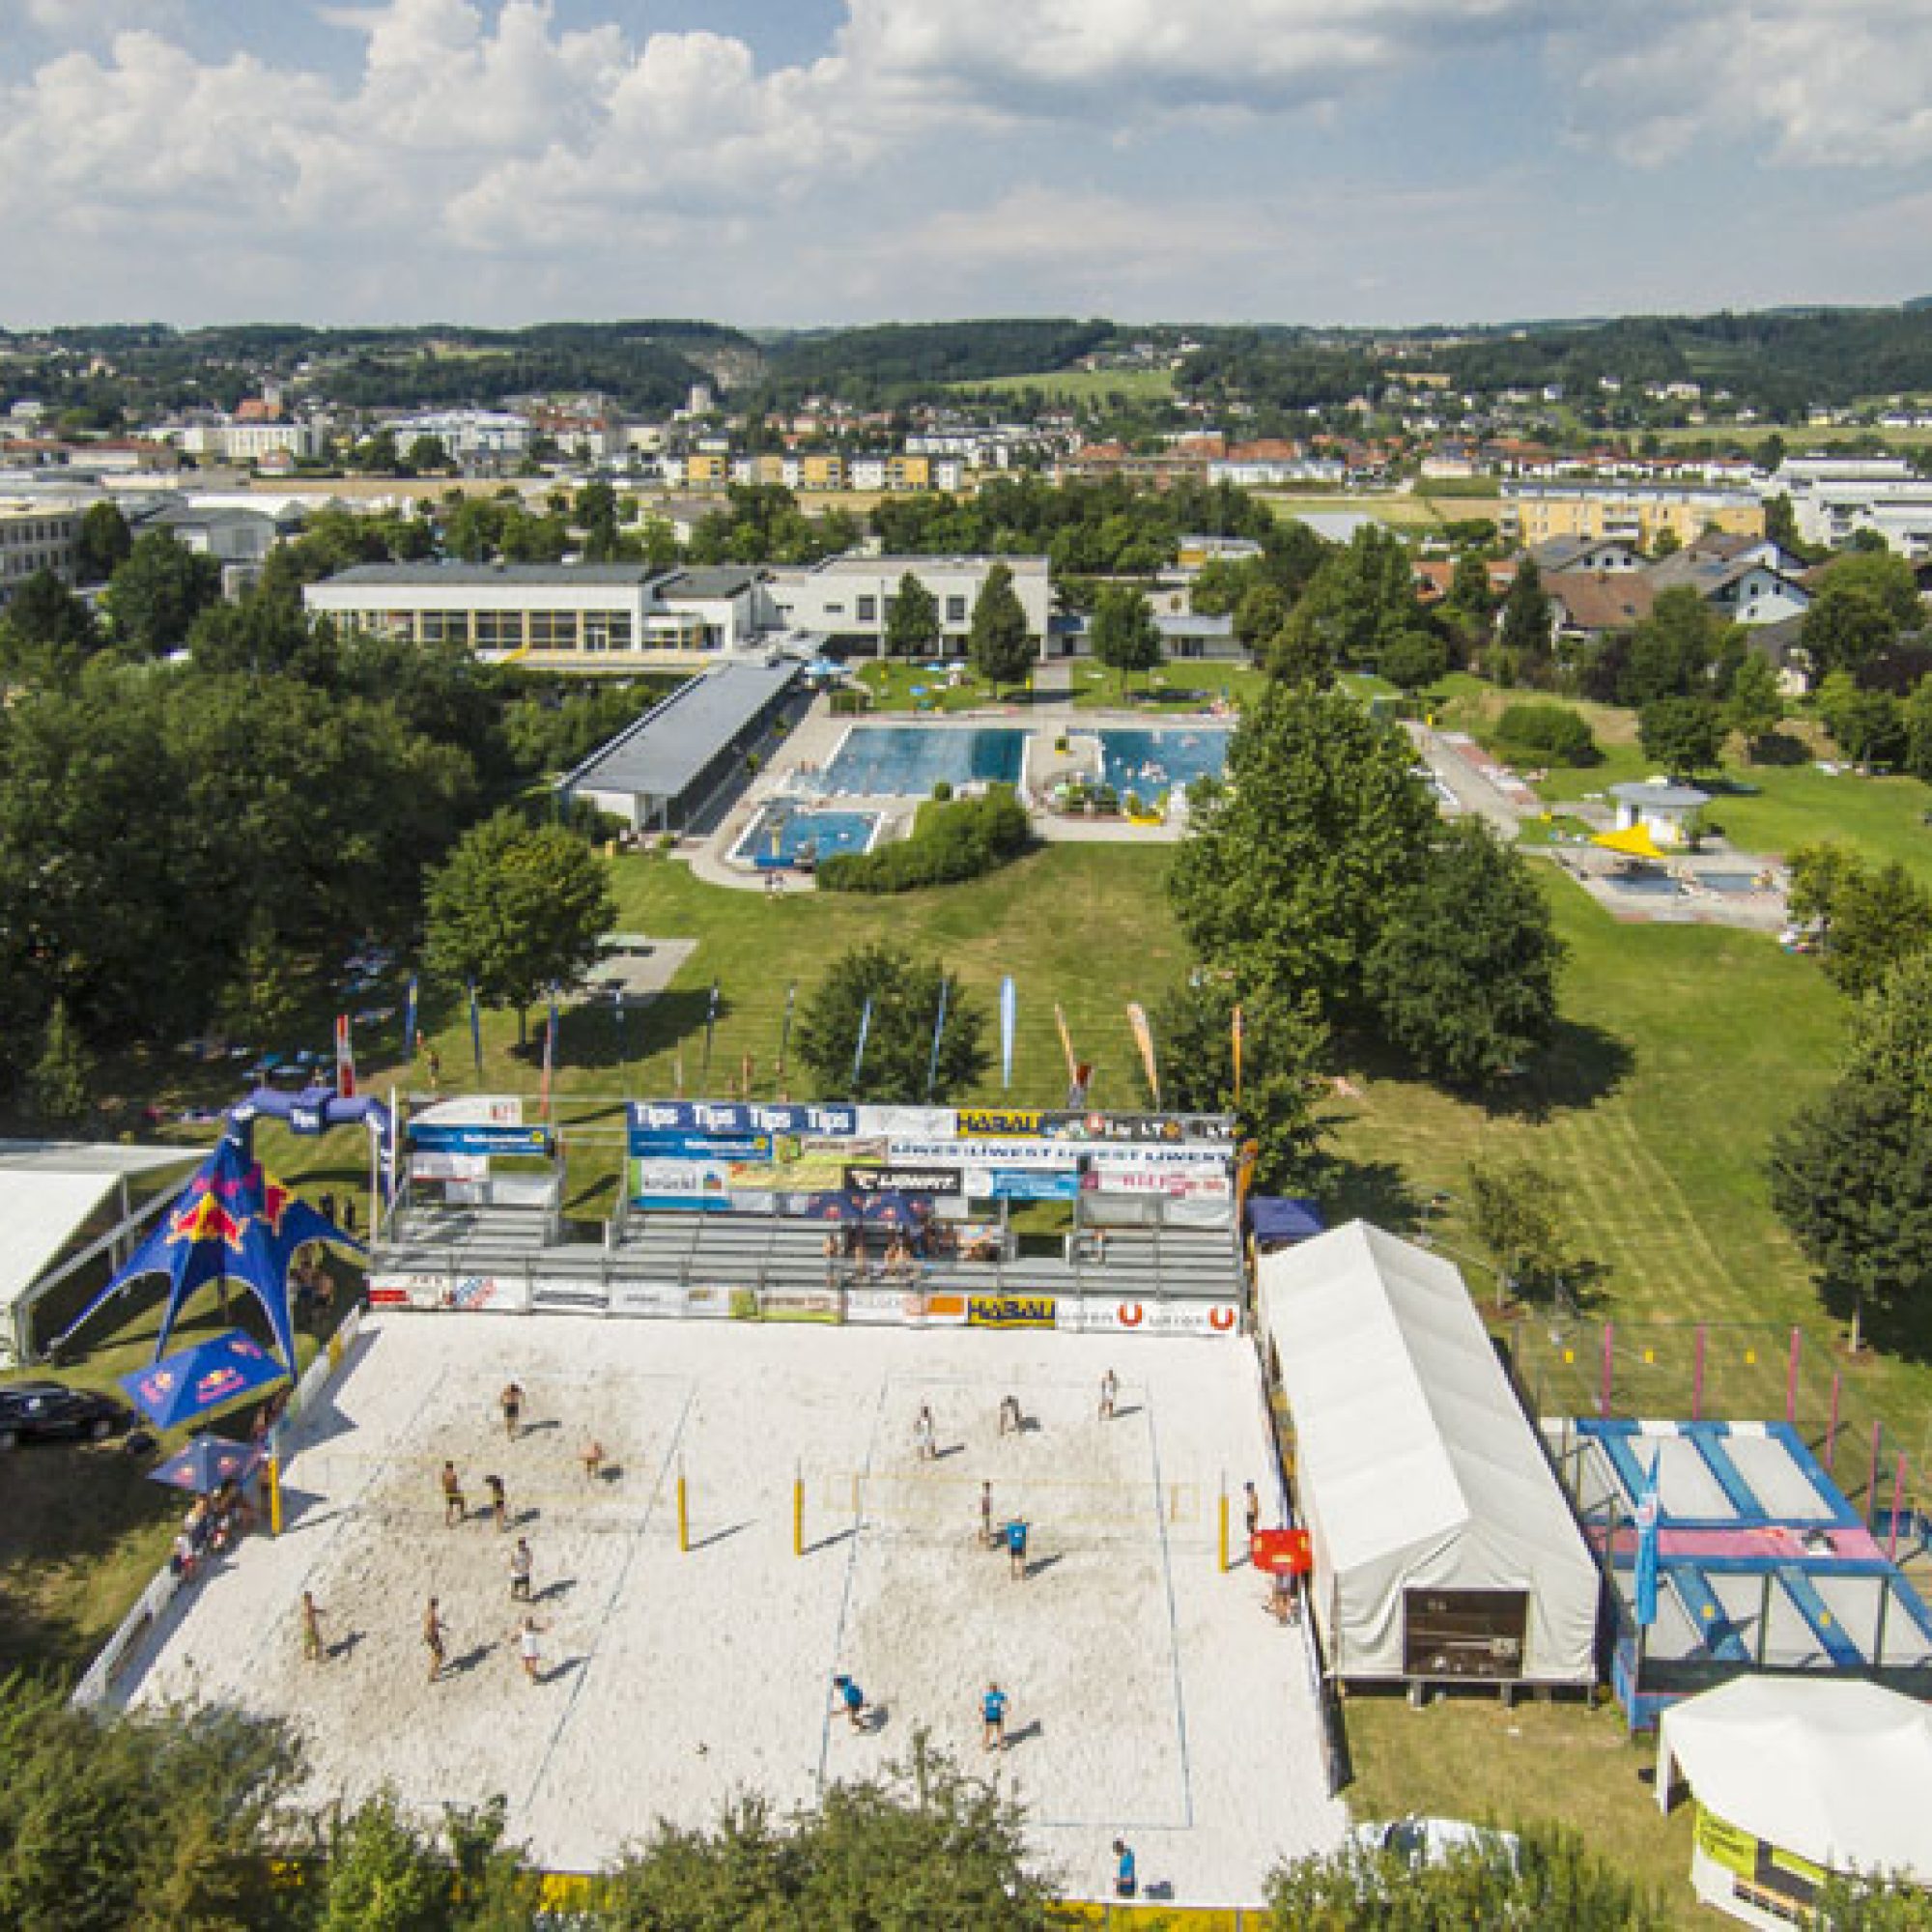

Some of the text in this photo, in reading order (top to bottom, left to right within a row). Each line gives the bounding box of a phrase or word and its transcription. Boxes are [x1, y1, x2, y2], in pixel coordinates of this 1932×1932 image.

[635, 1103, 850, 1134] Tips Tips Tips Tips
[968, 1300, 1056, 1321] HABAU
